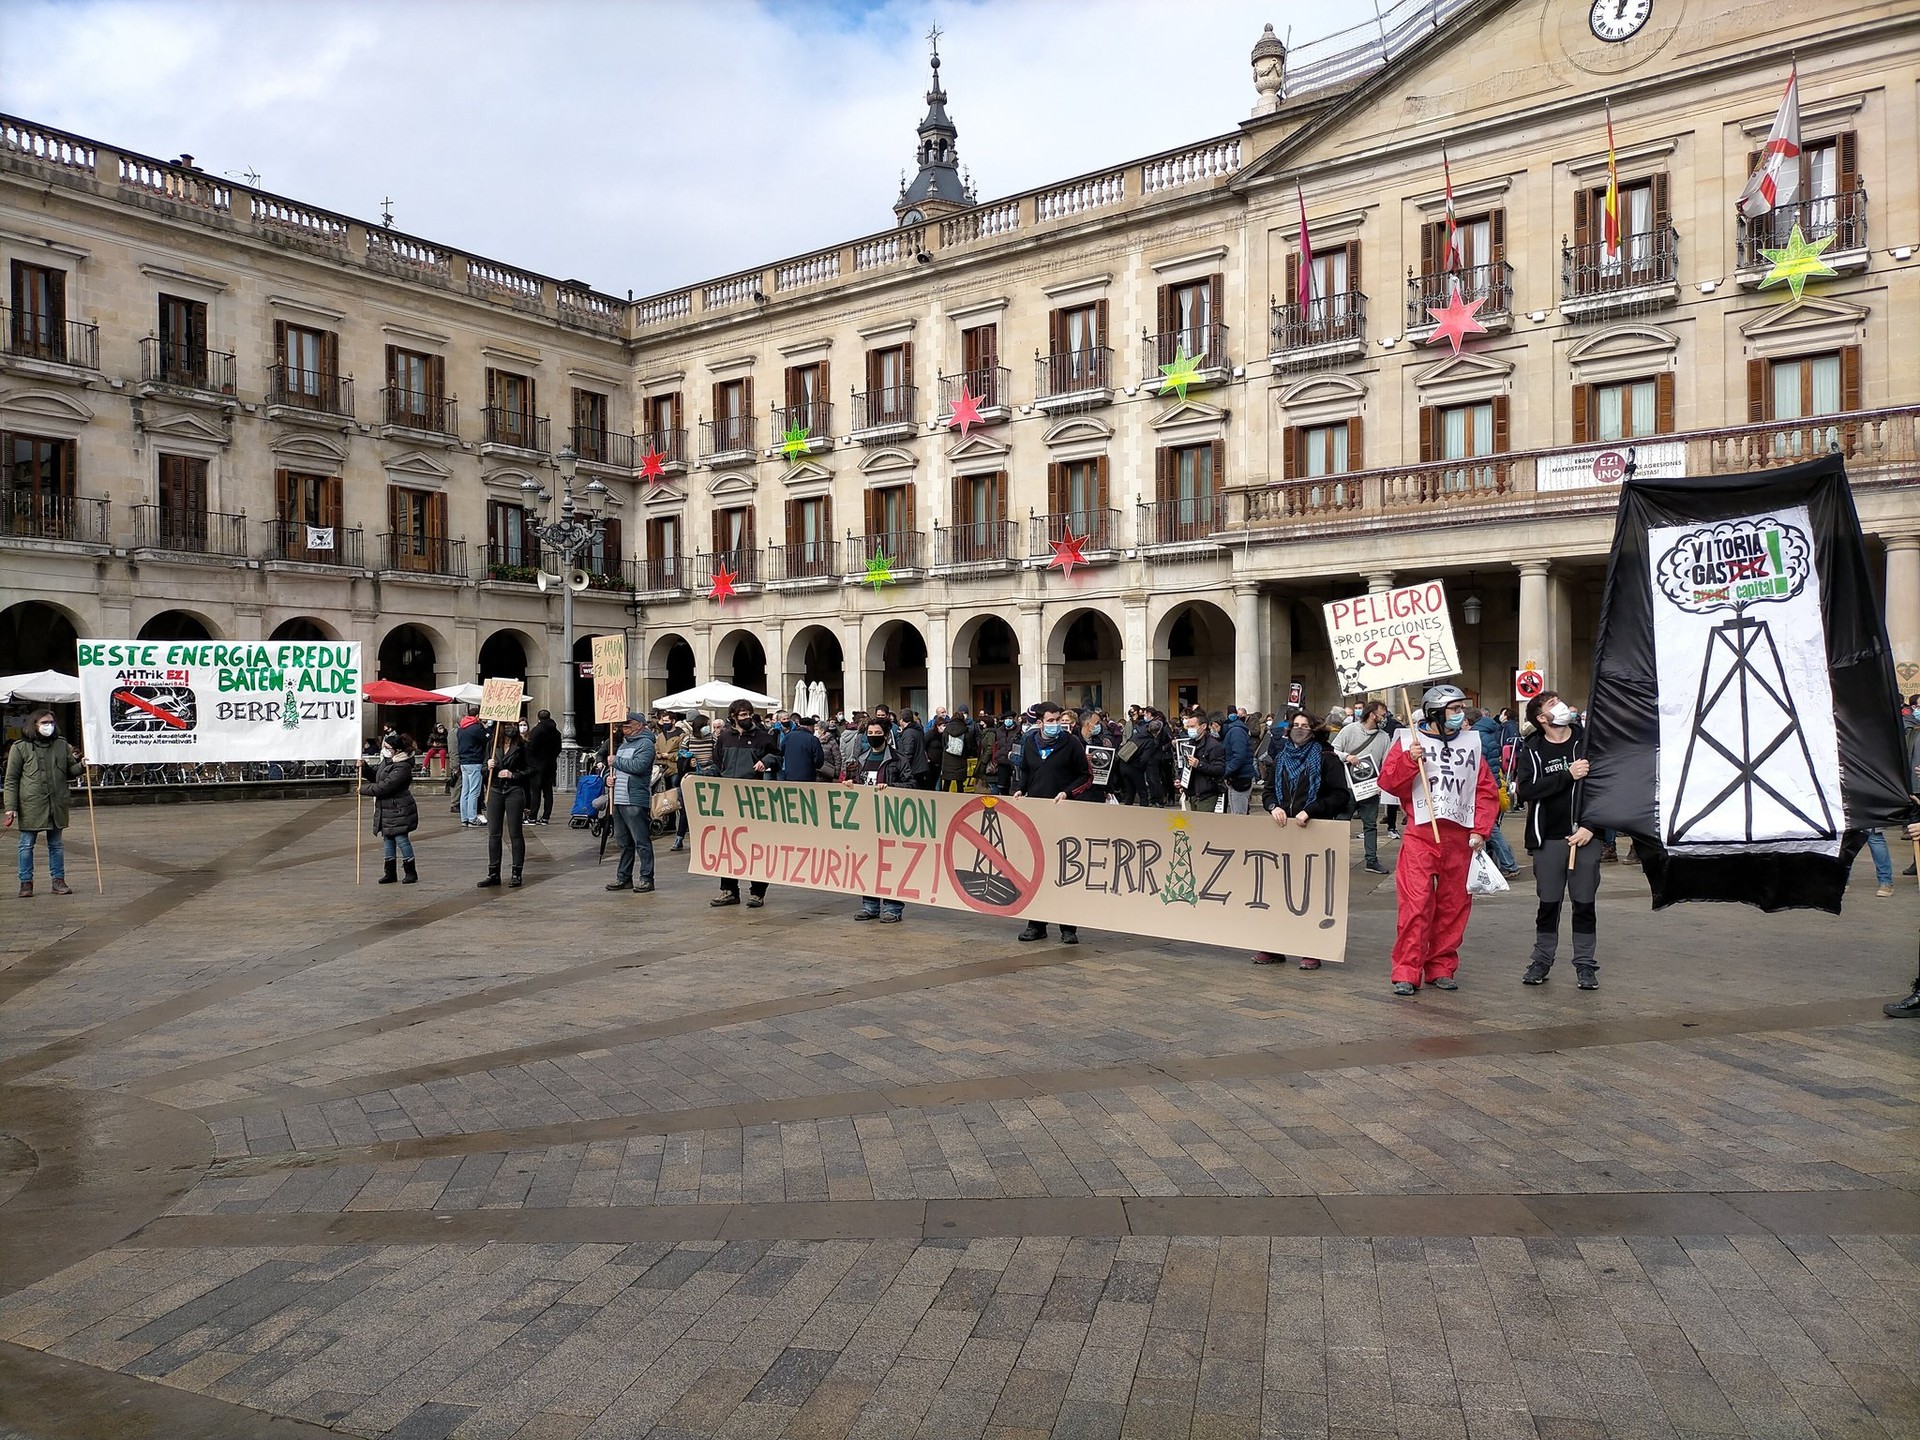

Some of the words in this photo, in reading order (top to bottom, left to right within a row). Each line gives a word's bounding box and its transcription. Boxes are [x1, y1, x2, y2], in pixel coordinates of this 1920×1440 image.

[1600, 456, 1618, 467] EZ!
[1598, 469, 1622, 479] ¡NO
[1691, 533, 1764, 563] VITORIA
[1736, 579, 1774, 600] capital
[1332, 584, 1442, 629] PELIGRO
[1335, 617, 1441, 646] PROSPECCIONES
[78, 645, 157, 666] BESTE
[166, 644, 272, 668] ENERGIA
[277, 645, 351, 668] EREDU
[1341, 648, 1355, 660] DE
[1364, 635, 1425, 666] GAS
[115, 669, 164, 680] AHTrik
[123, 679, 146, 687] Tren
[218, 668, 284, 692] BATEN
[297, 669, 357, 693] ALDE
[1428, 776, 1466, 796] PNV
[695, 782, 725, 817] EZ
[734, 784, 819, 827] HEMEN
[828, 790, 860, 830] EZ
[873, 788, 937, 838] INON
[875, 838, 942, 903] EZ!
